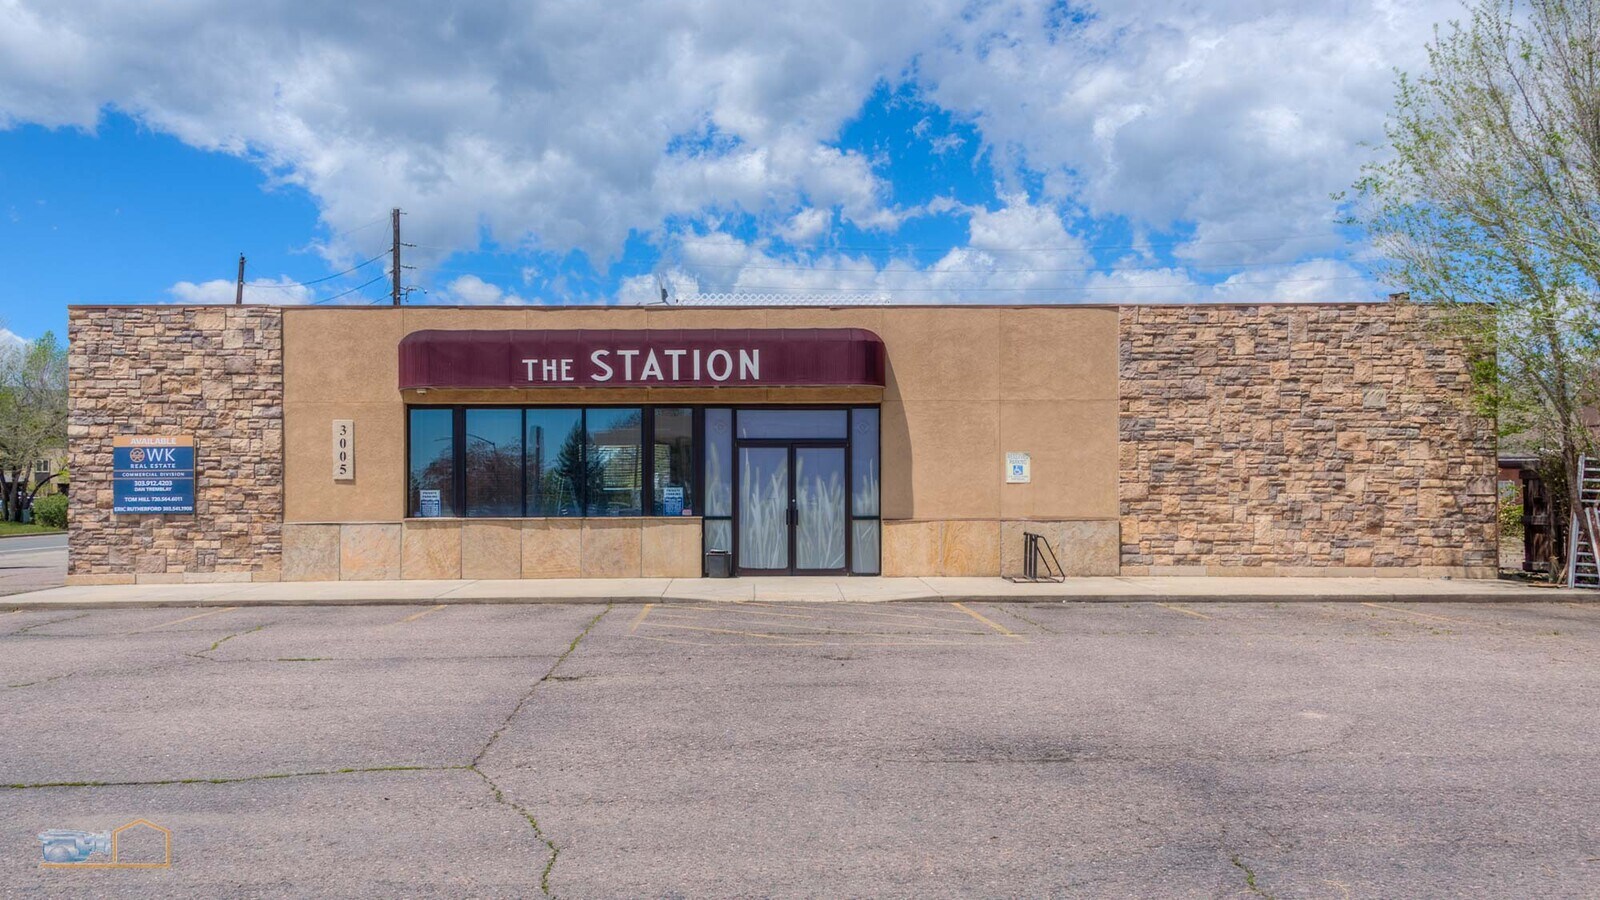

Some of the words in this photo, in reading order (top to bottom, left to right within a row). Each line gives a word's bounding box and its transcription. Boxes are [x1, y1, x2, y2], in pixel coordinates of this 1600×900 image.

[522, 359, 574, 381] THE
[590, 348, 760, 382] STATION
[130, 437, 177, 445] AVAILABLE
[339, 424, 347, 475] 3005
[146, 448, 176, 462] WK
